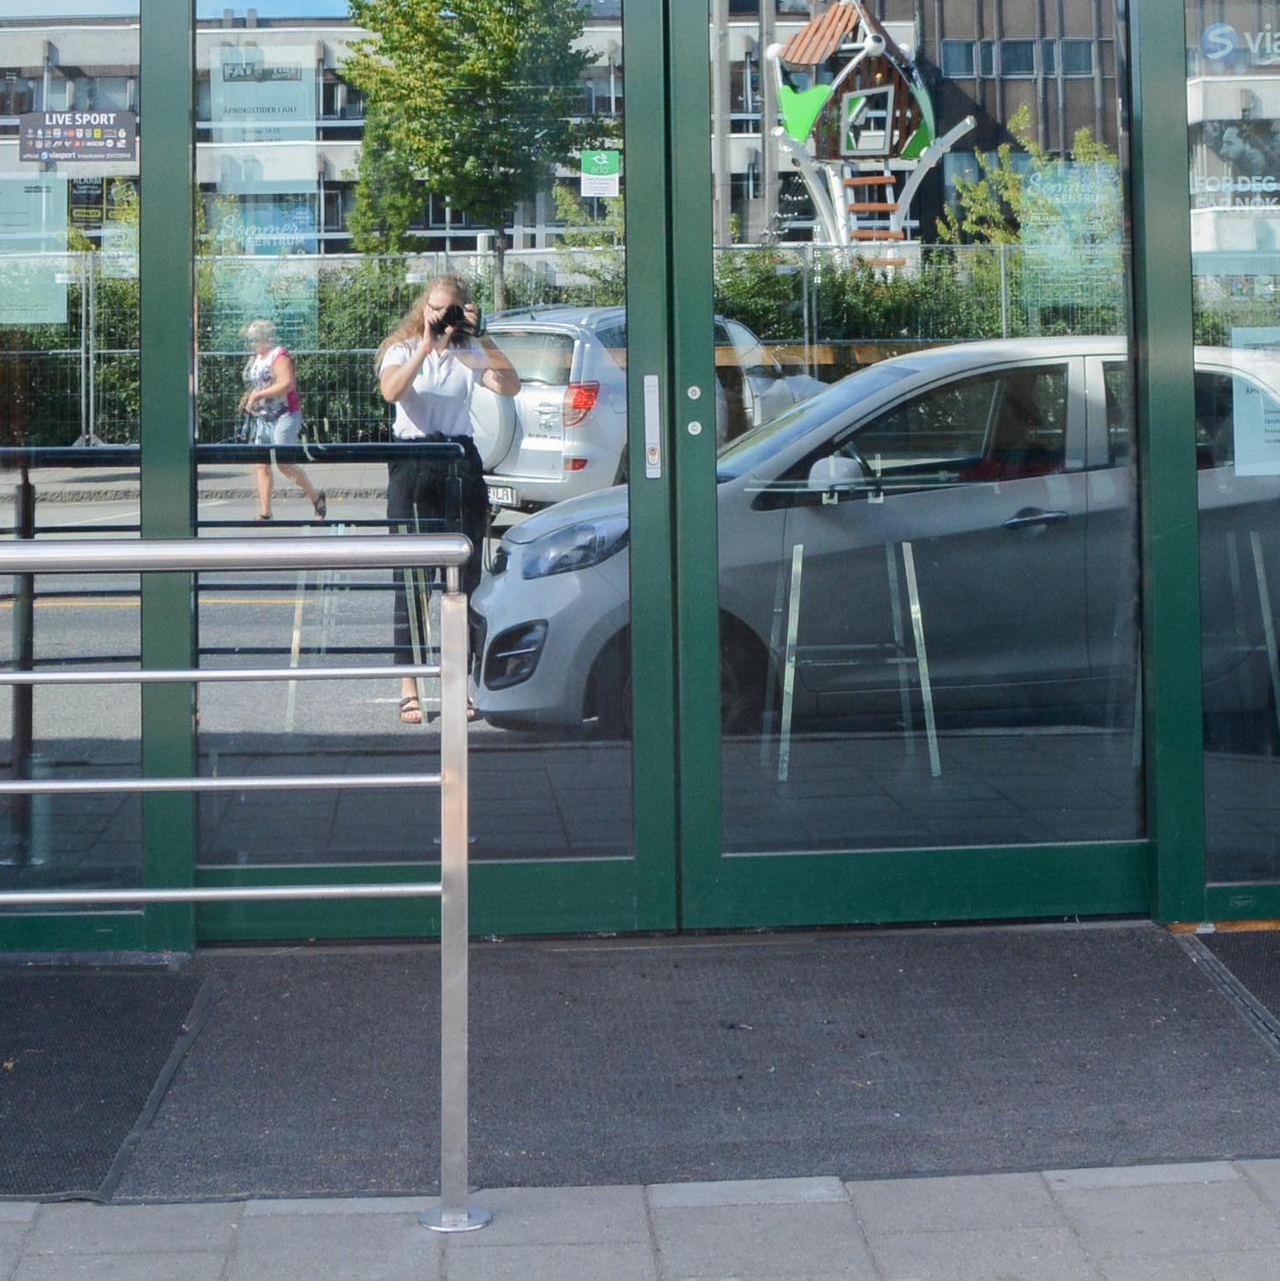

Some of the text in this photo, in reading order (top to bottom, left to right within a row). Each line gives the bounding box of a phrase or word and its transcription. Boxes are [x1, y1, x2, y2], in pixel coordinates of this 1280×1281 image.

[45, 113, 117, 125] LIVE SPORT
[1237, 175, 1277, 193] DEG
